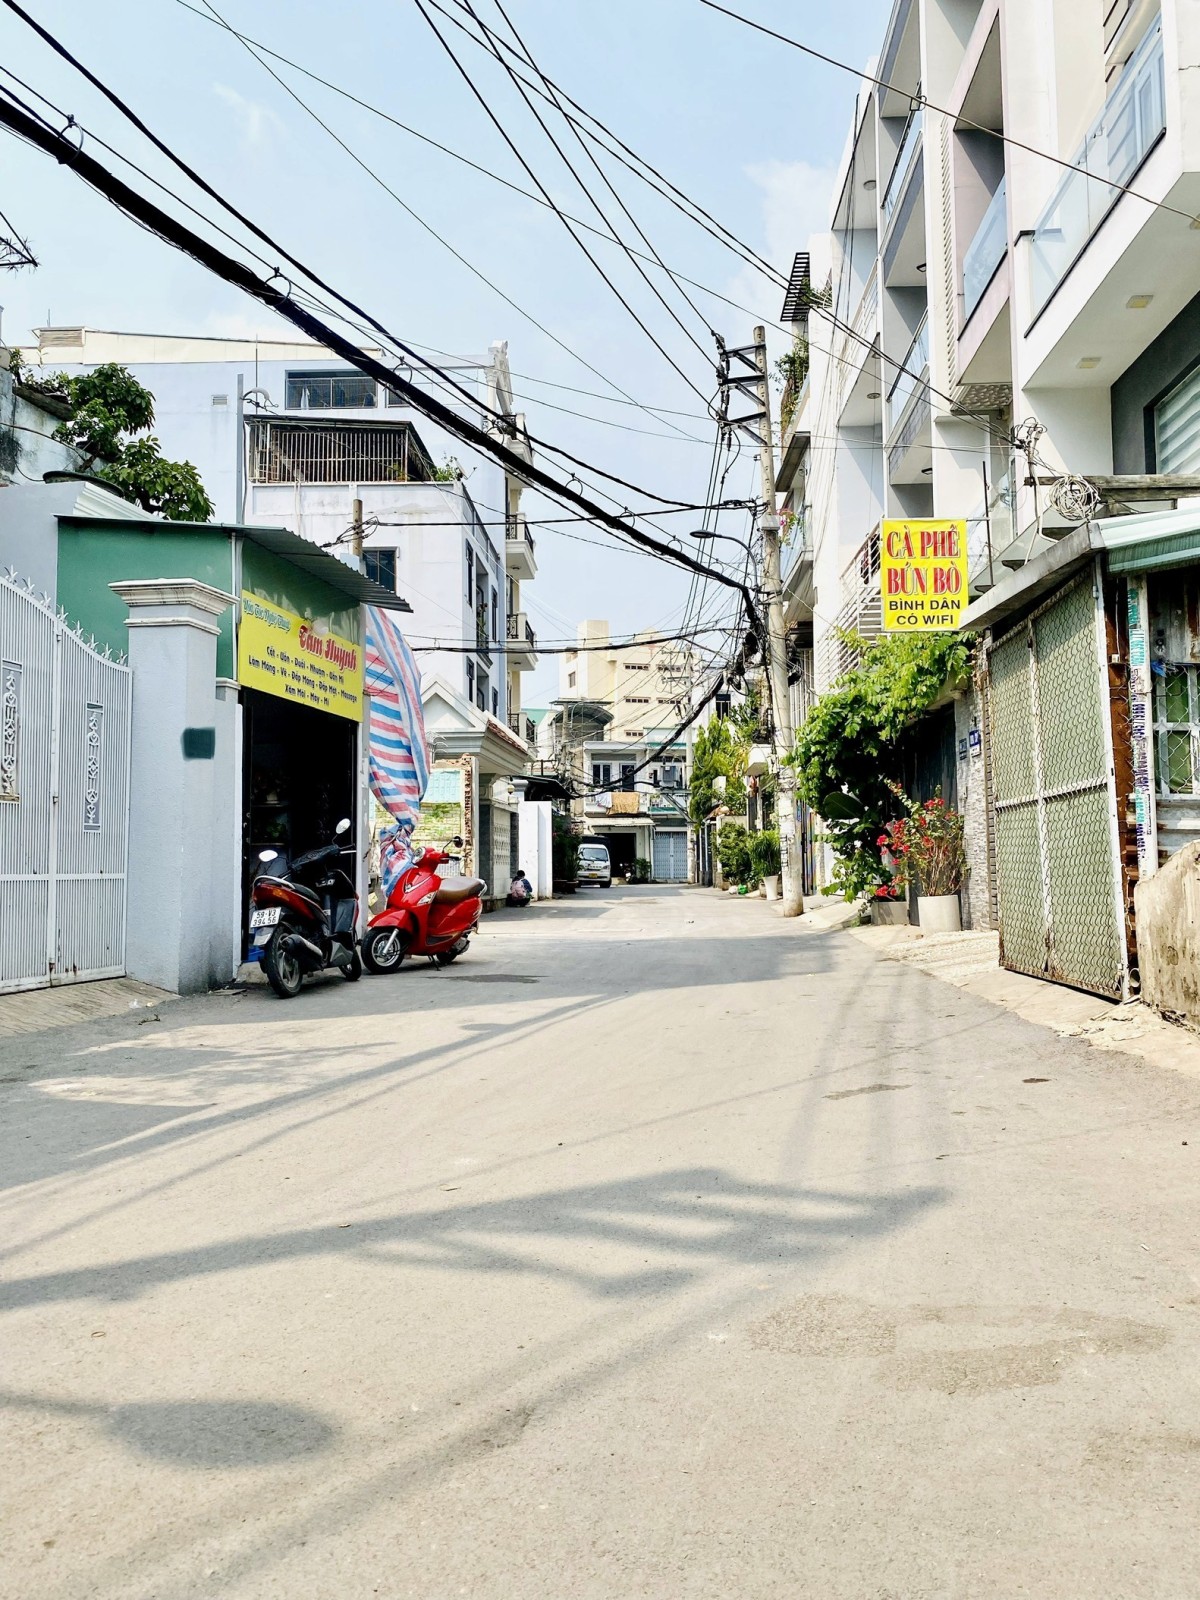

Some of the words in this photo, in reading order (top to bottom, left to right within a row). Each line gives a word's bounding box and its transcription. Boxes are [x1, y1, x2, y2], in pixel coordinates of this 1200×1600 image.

[886, 525, 915, 558] CÀ
[920, 524, 960, 558] PHÊ
[887, 562, 928, 595] BÚN
[933, 560, 962, 595] BÒ
[889, 598, 924, 610] BÌNH
[930, 597, 960, 610] DÂN
[896, 613, 918, 625] CÓ
[922, 614, 954, 624] WIFI
